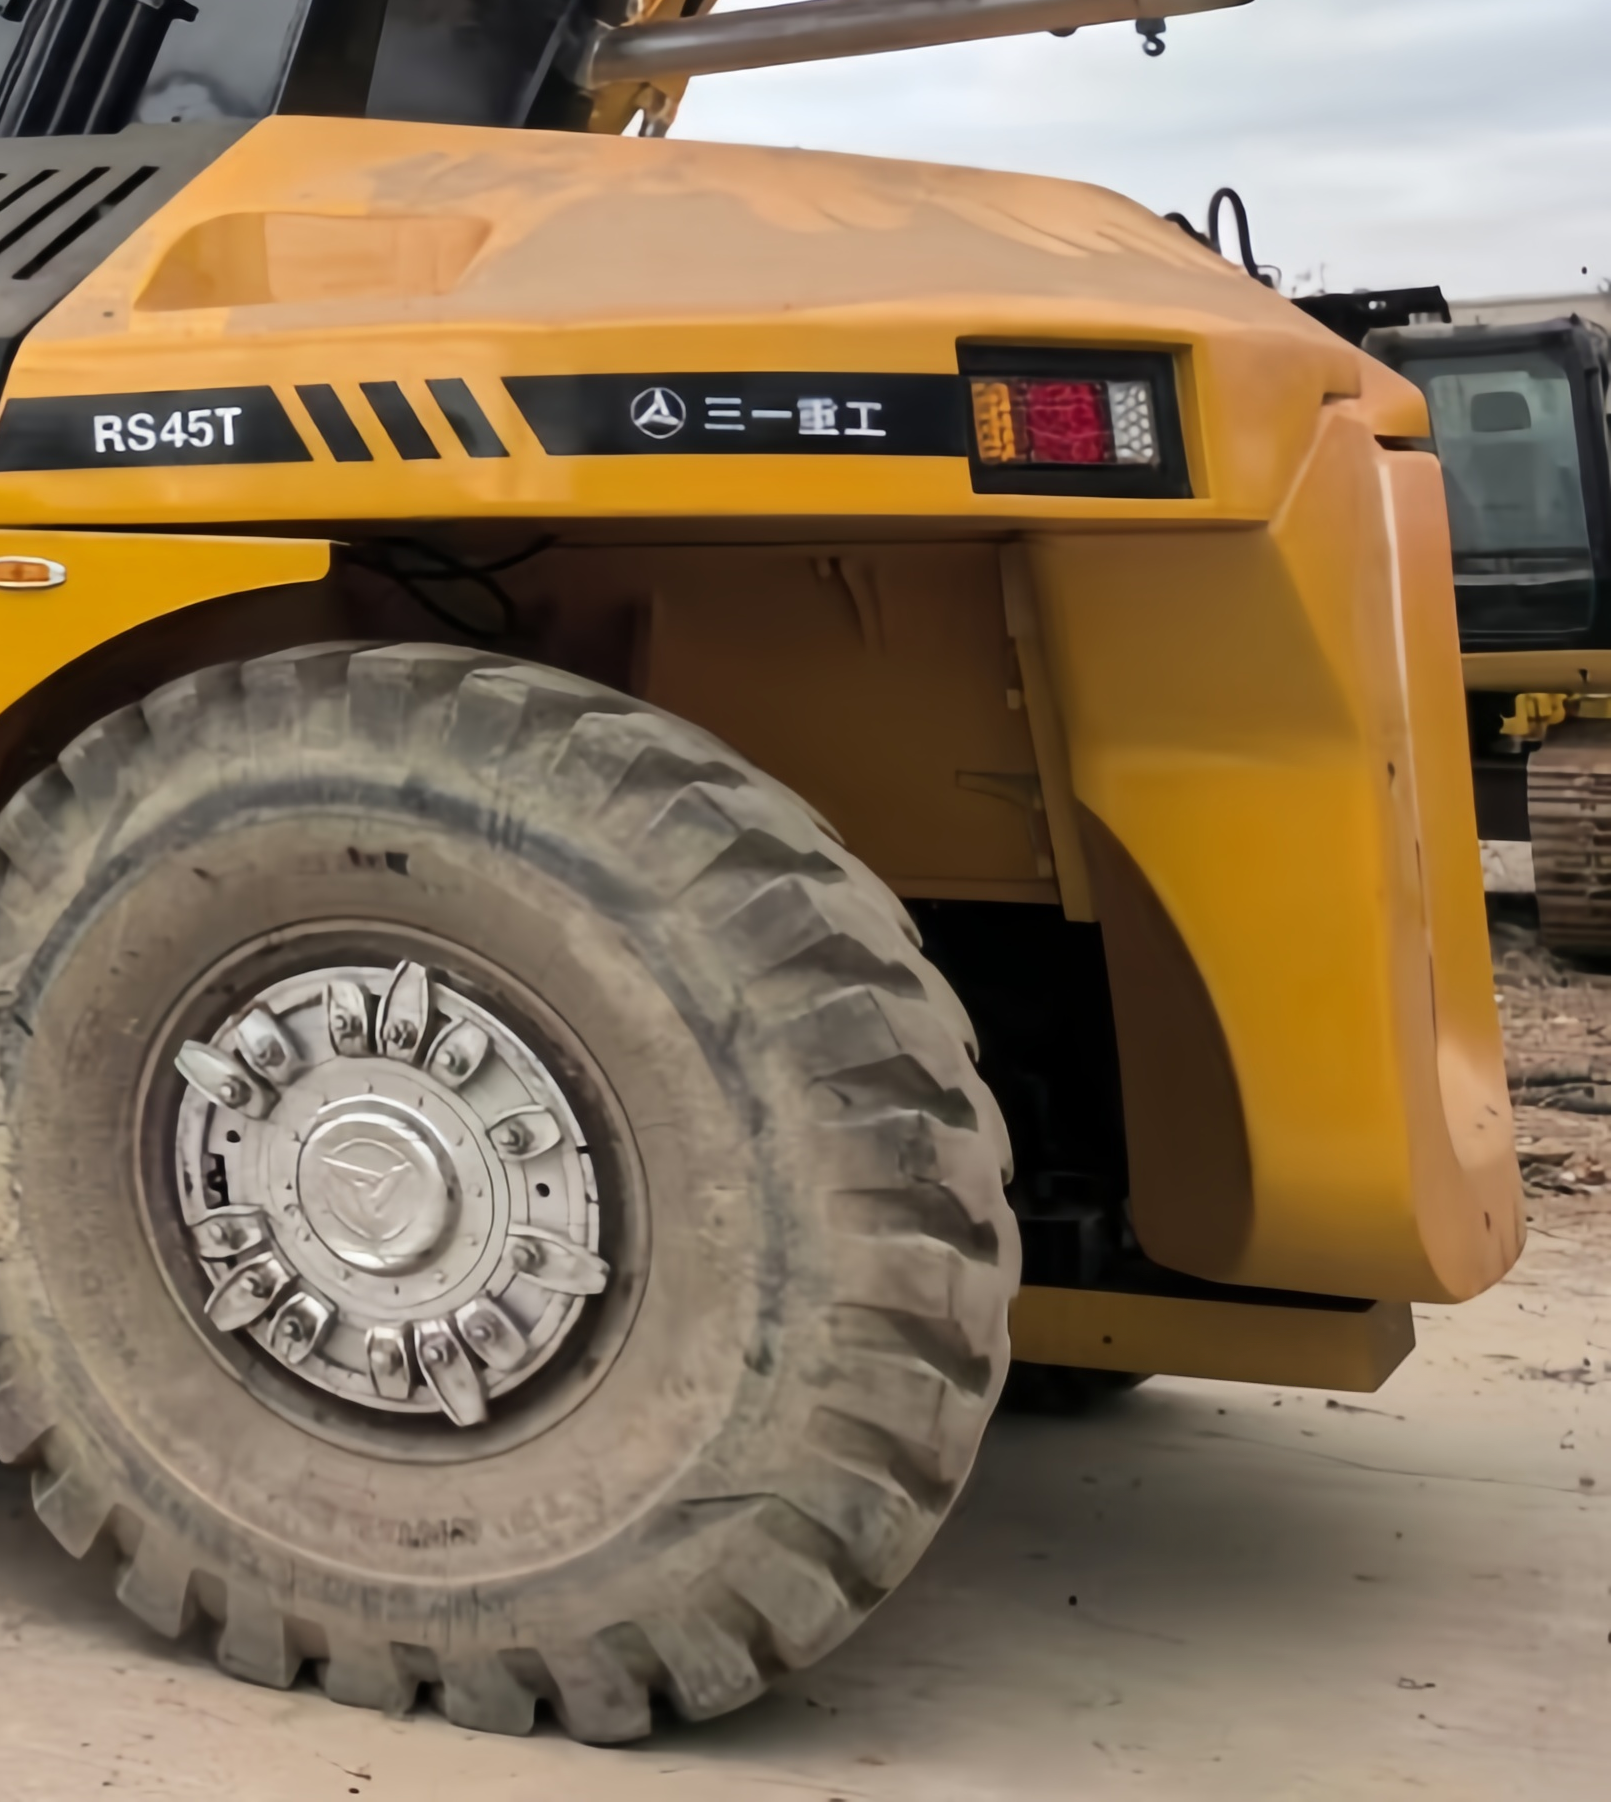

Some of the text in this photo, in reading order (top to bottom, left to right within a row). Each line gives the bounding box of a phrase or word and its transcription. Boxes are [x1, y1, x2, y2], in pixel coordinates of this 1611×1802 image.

[93, 406, 243, 454] RS45T
[703, 396, 888, 437] 三一重工
